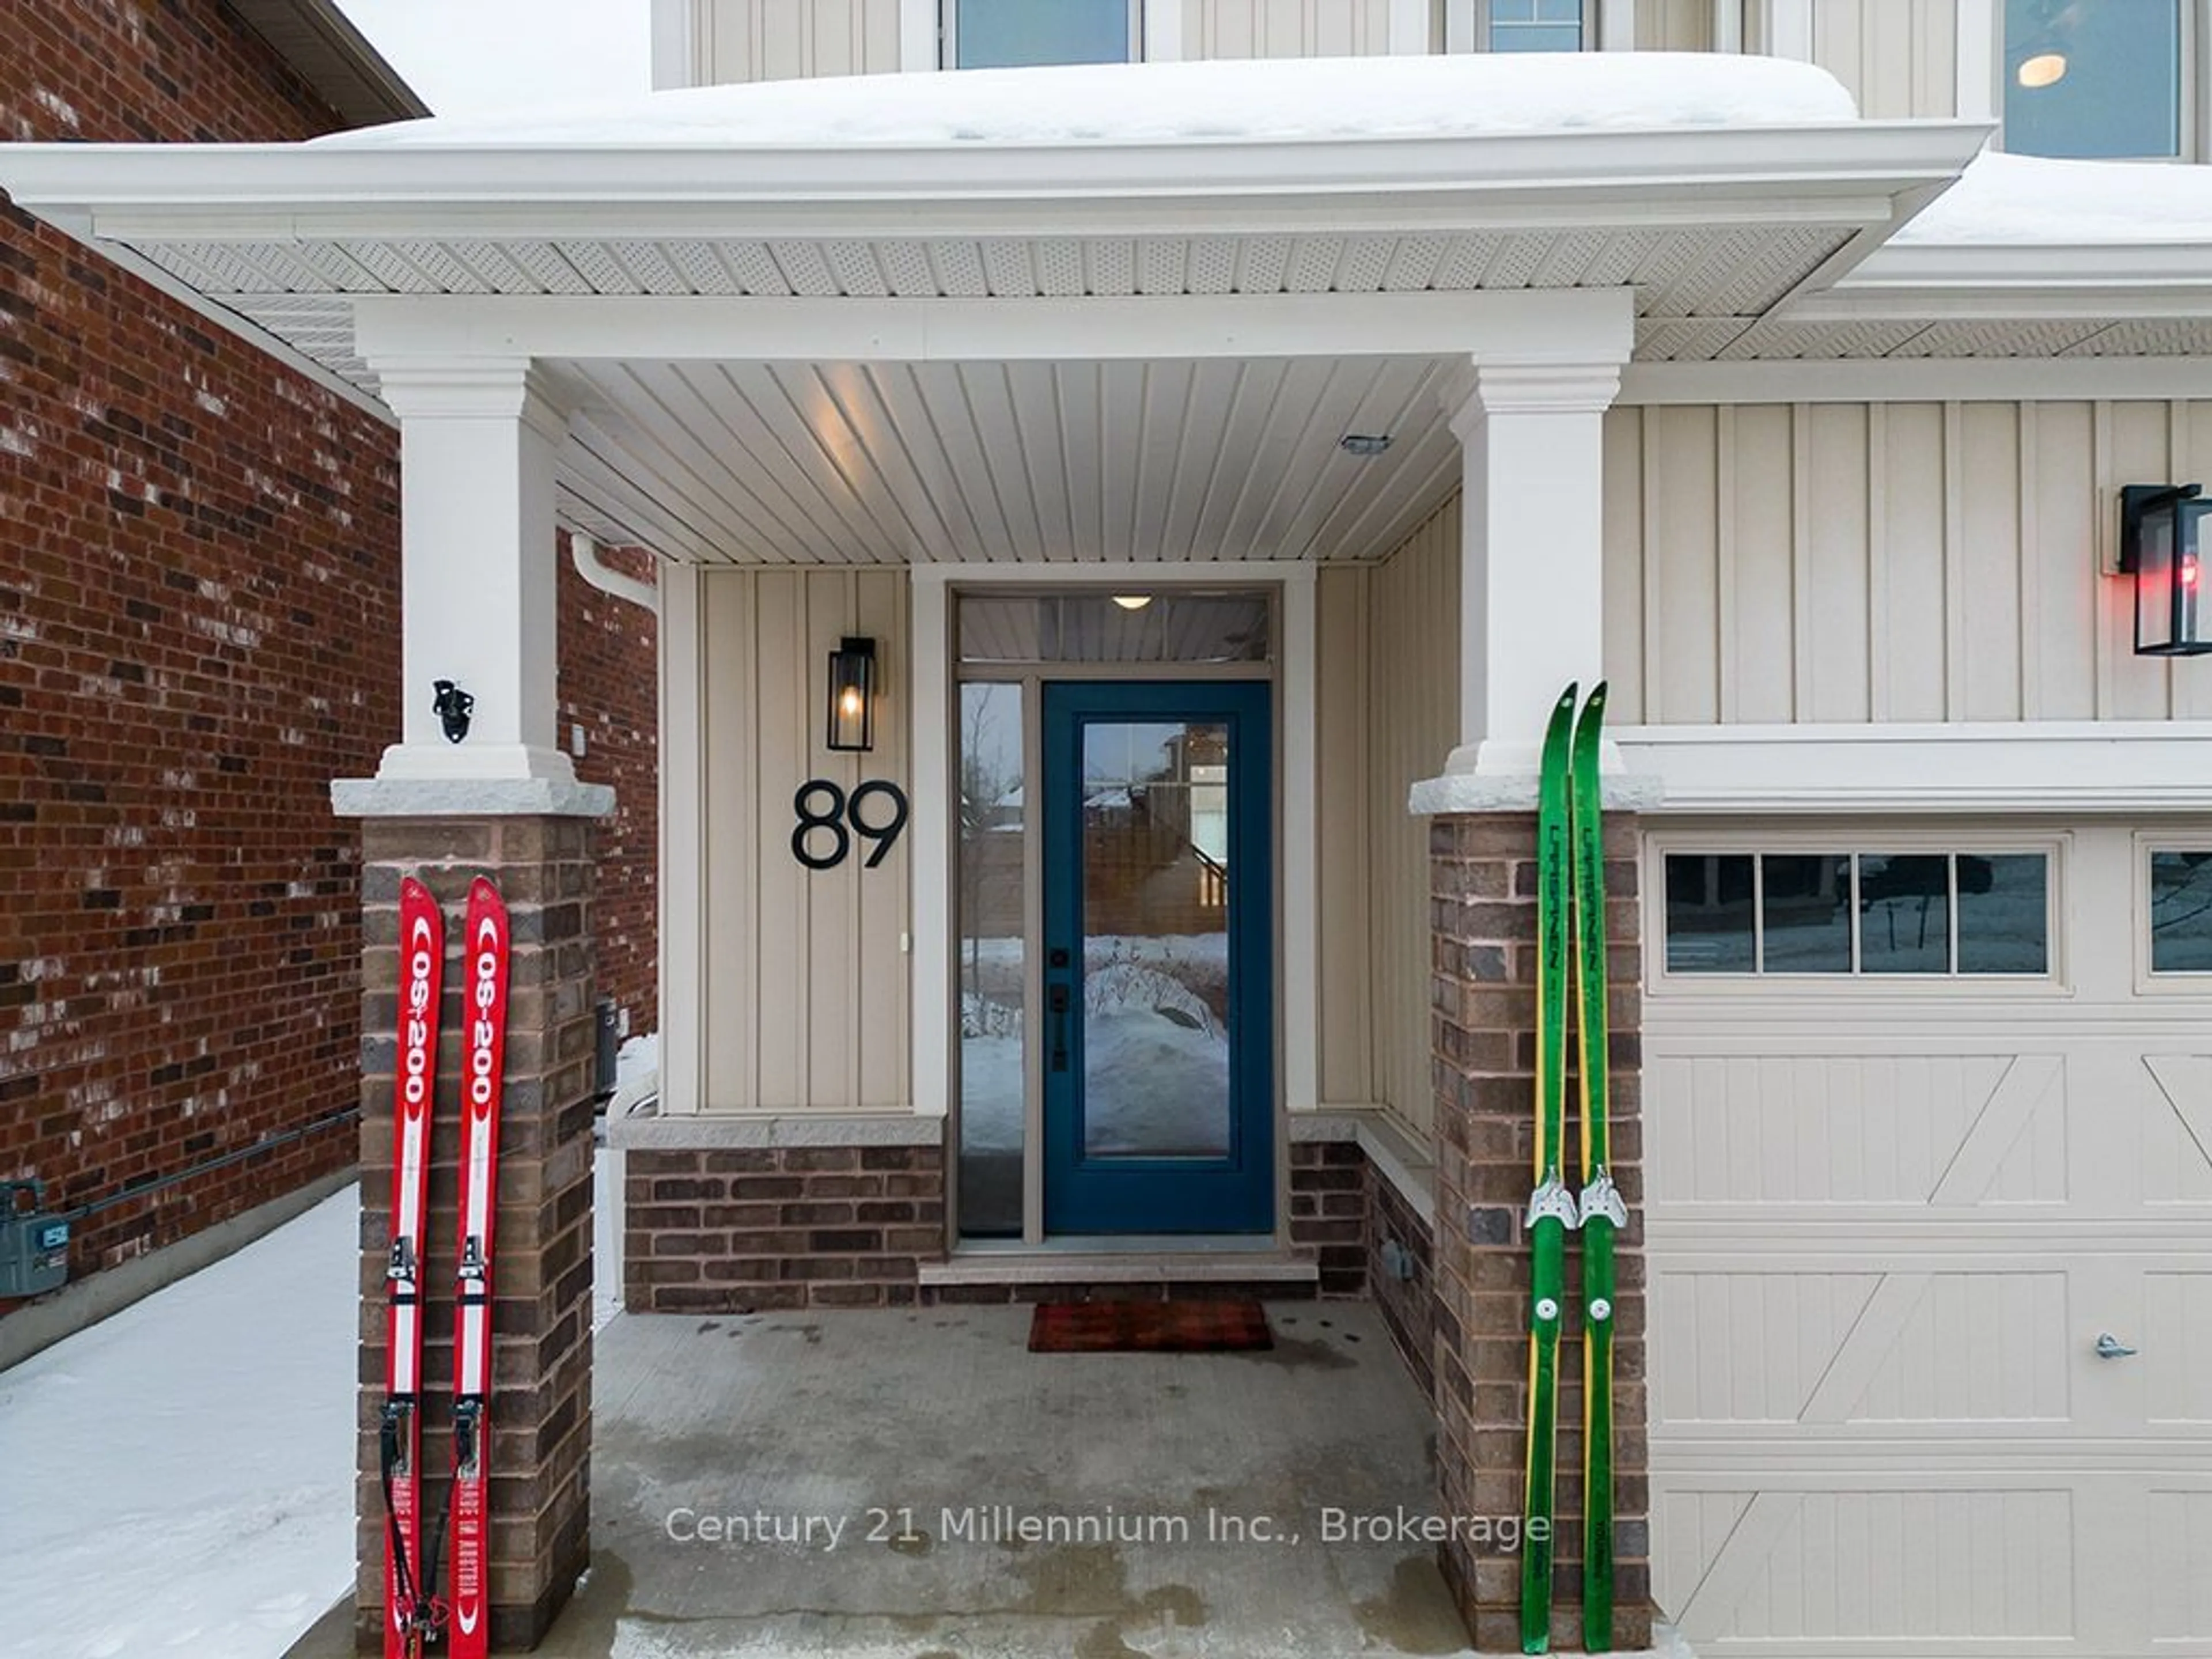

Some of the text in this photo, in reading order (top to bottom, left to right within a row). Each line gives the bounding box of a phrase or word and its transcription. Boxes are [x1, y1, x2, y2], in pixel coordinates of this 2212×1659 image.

[791, 779, 908, 869] 89
[406, 951, 431, 1104] OS-200
[472, 952, 496, 1104] OS-200
